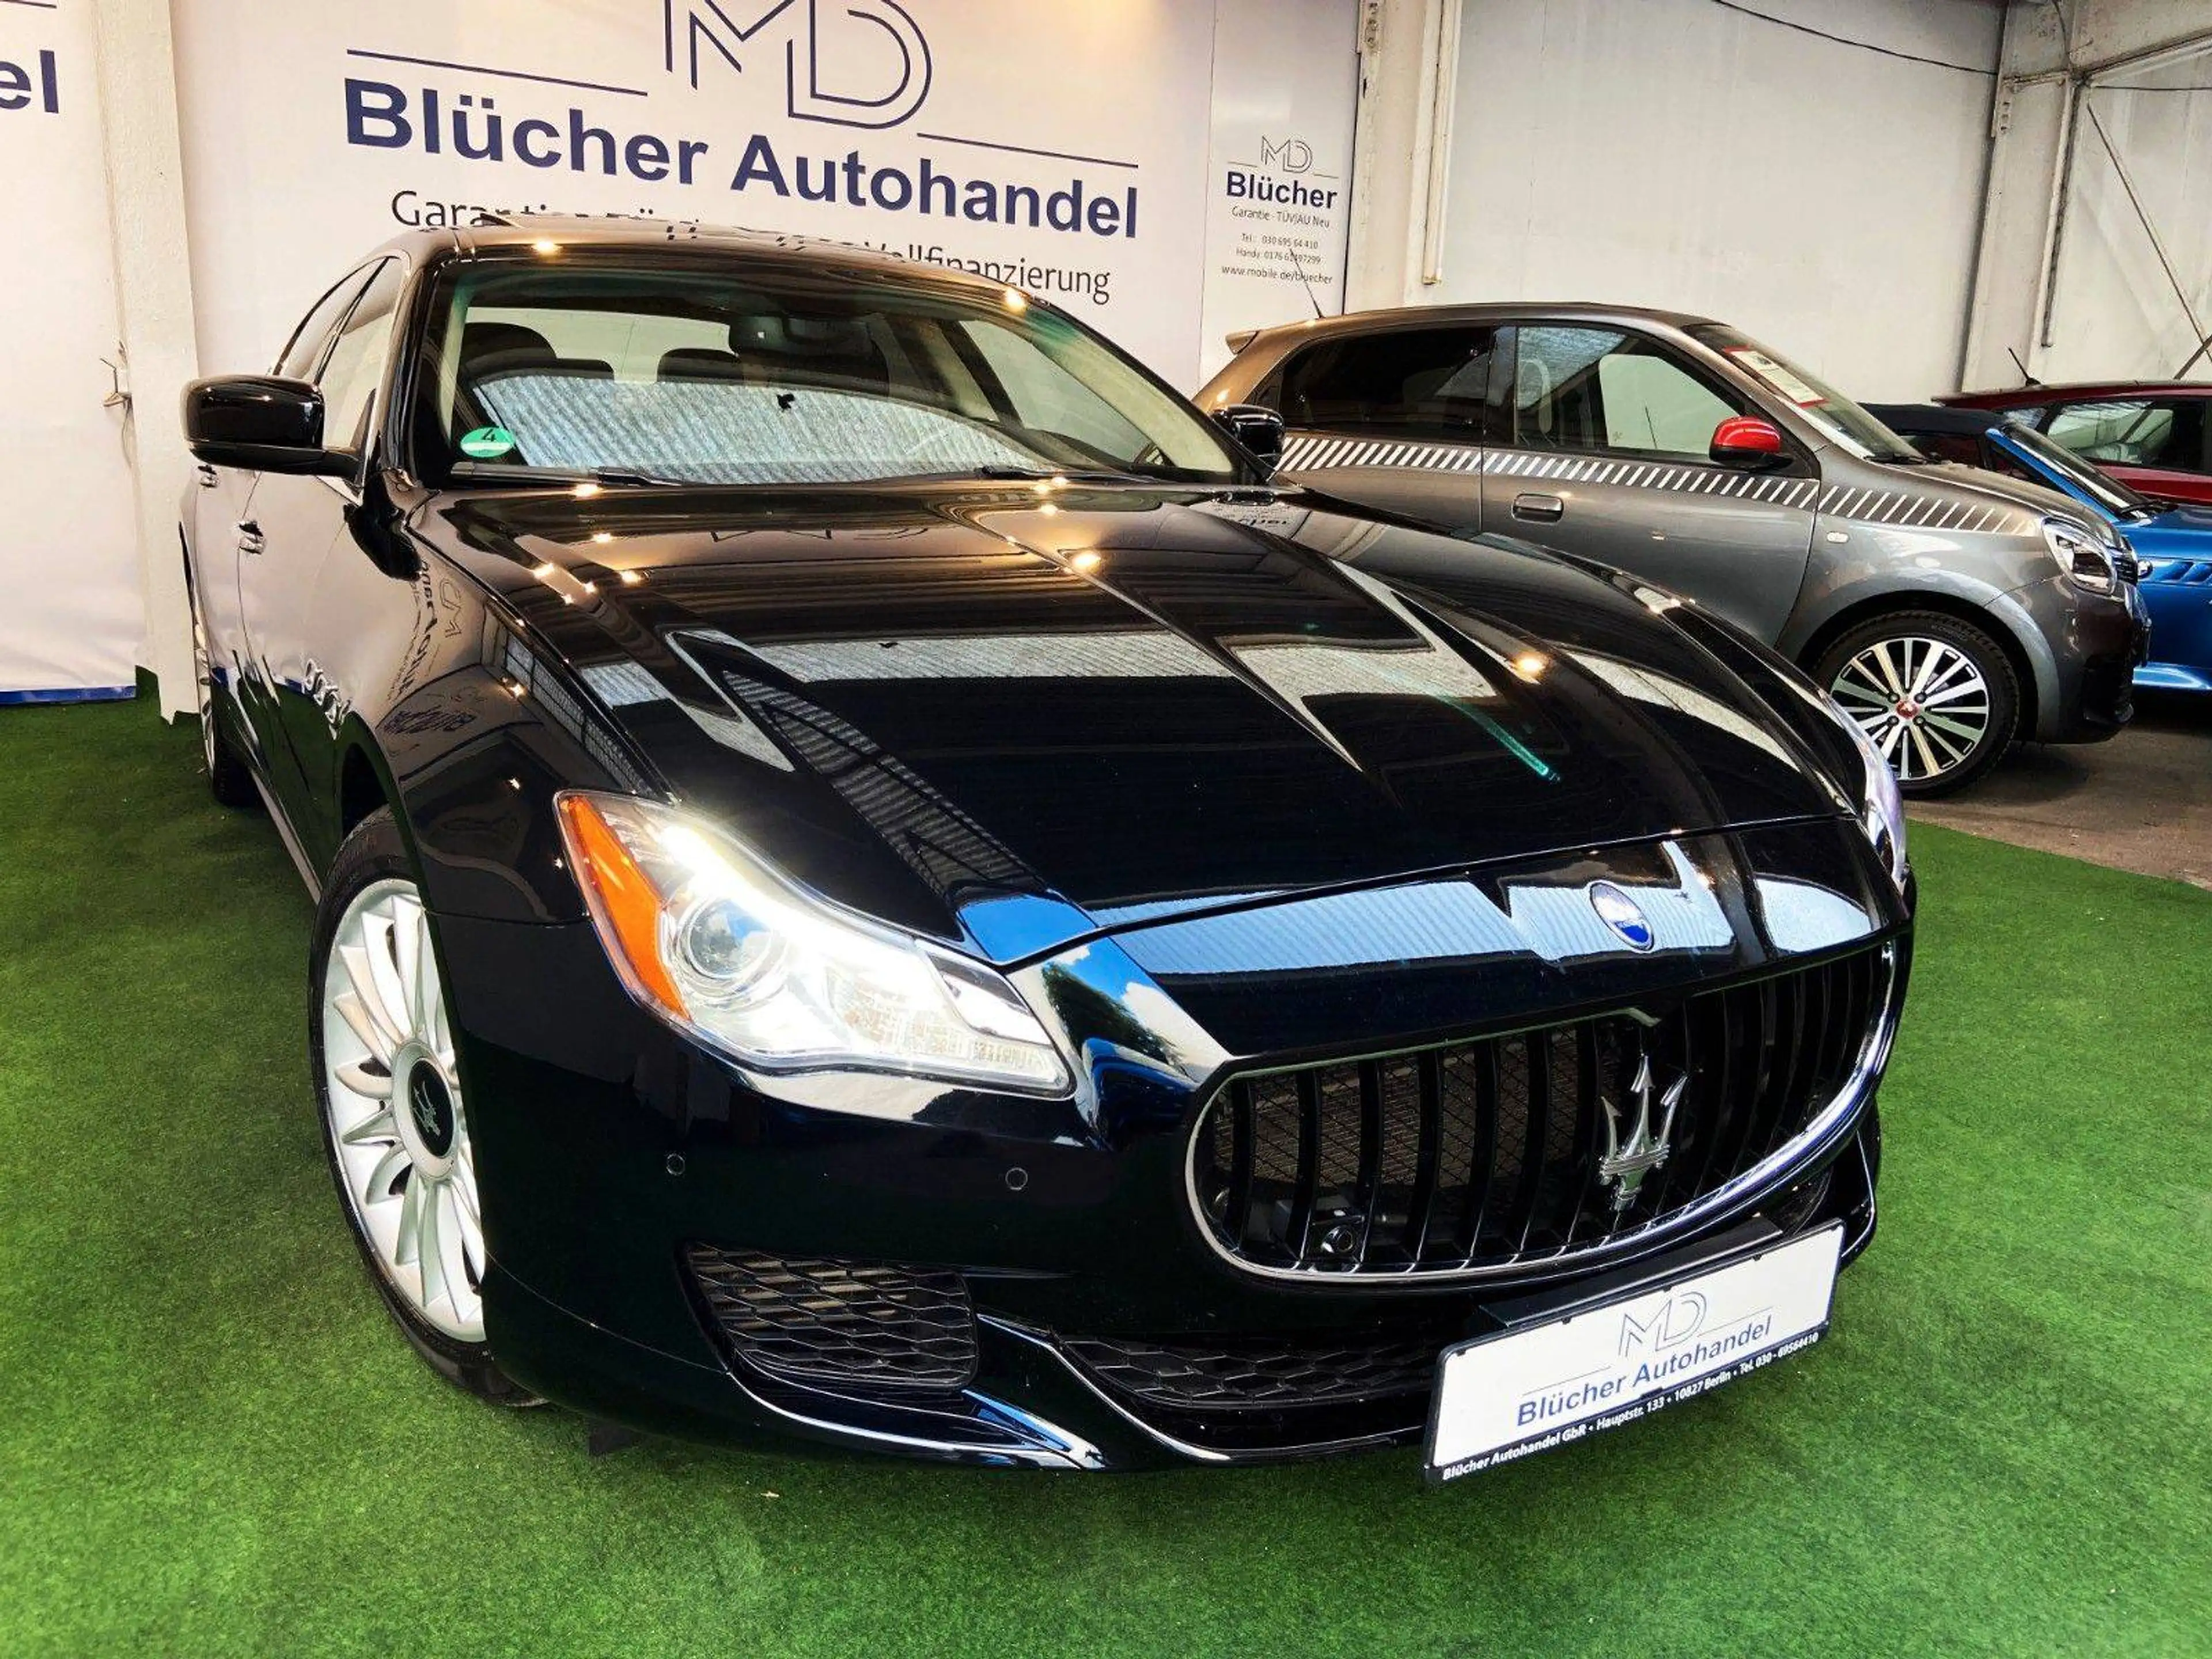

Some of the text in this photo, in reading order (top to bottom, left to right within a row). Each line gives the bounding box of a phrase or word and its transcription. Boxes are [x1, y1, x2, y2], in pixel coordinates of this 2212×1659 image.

[344, 78, 1138, 238] Blücher Autohandel
[1261, 135, 1313, 173] MD
[1226, 171, 1338, 209] Blücher
[1232, 206, 1270, 221] Garantie
[1313, 215, 1330, 228] Neu
[482, 429, 496, 441] 4
[1618, 1291, 1707, 1358] MD
[1517, 1314, 1772, 1426] Blücher Autohandel
[1442, 1457, 1491, 1481] Blücher
[1490, 1432, 1560, 1465] Autohandel
[1562, 1423, 1586, 1442] GbR
[1596, 1406, 1645, 1431] Hauptstr.
[1646, 1396, 1665, 1412] 133
[1675, 1380, 1704, 1402] 10827
[1703, 1370, 1732, 1391] Berlin
[1755, 1352, 1772, 1368] 030
